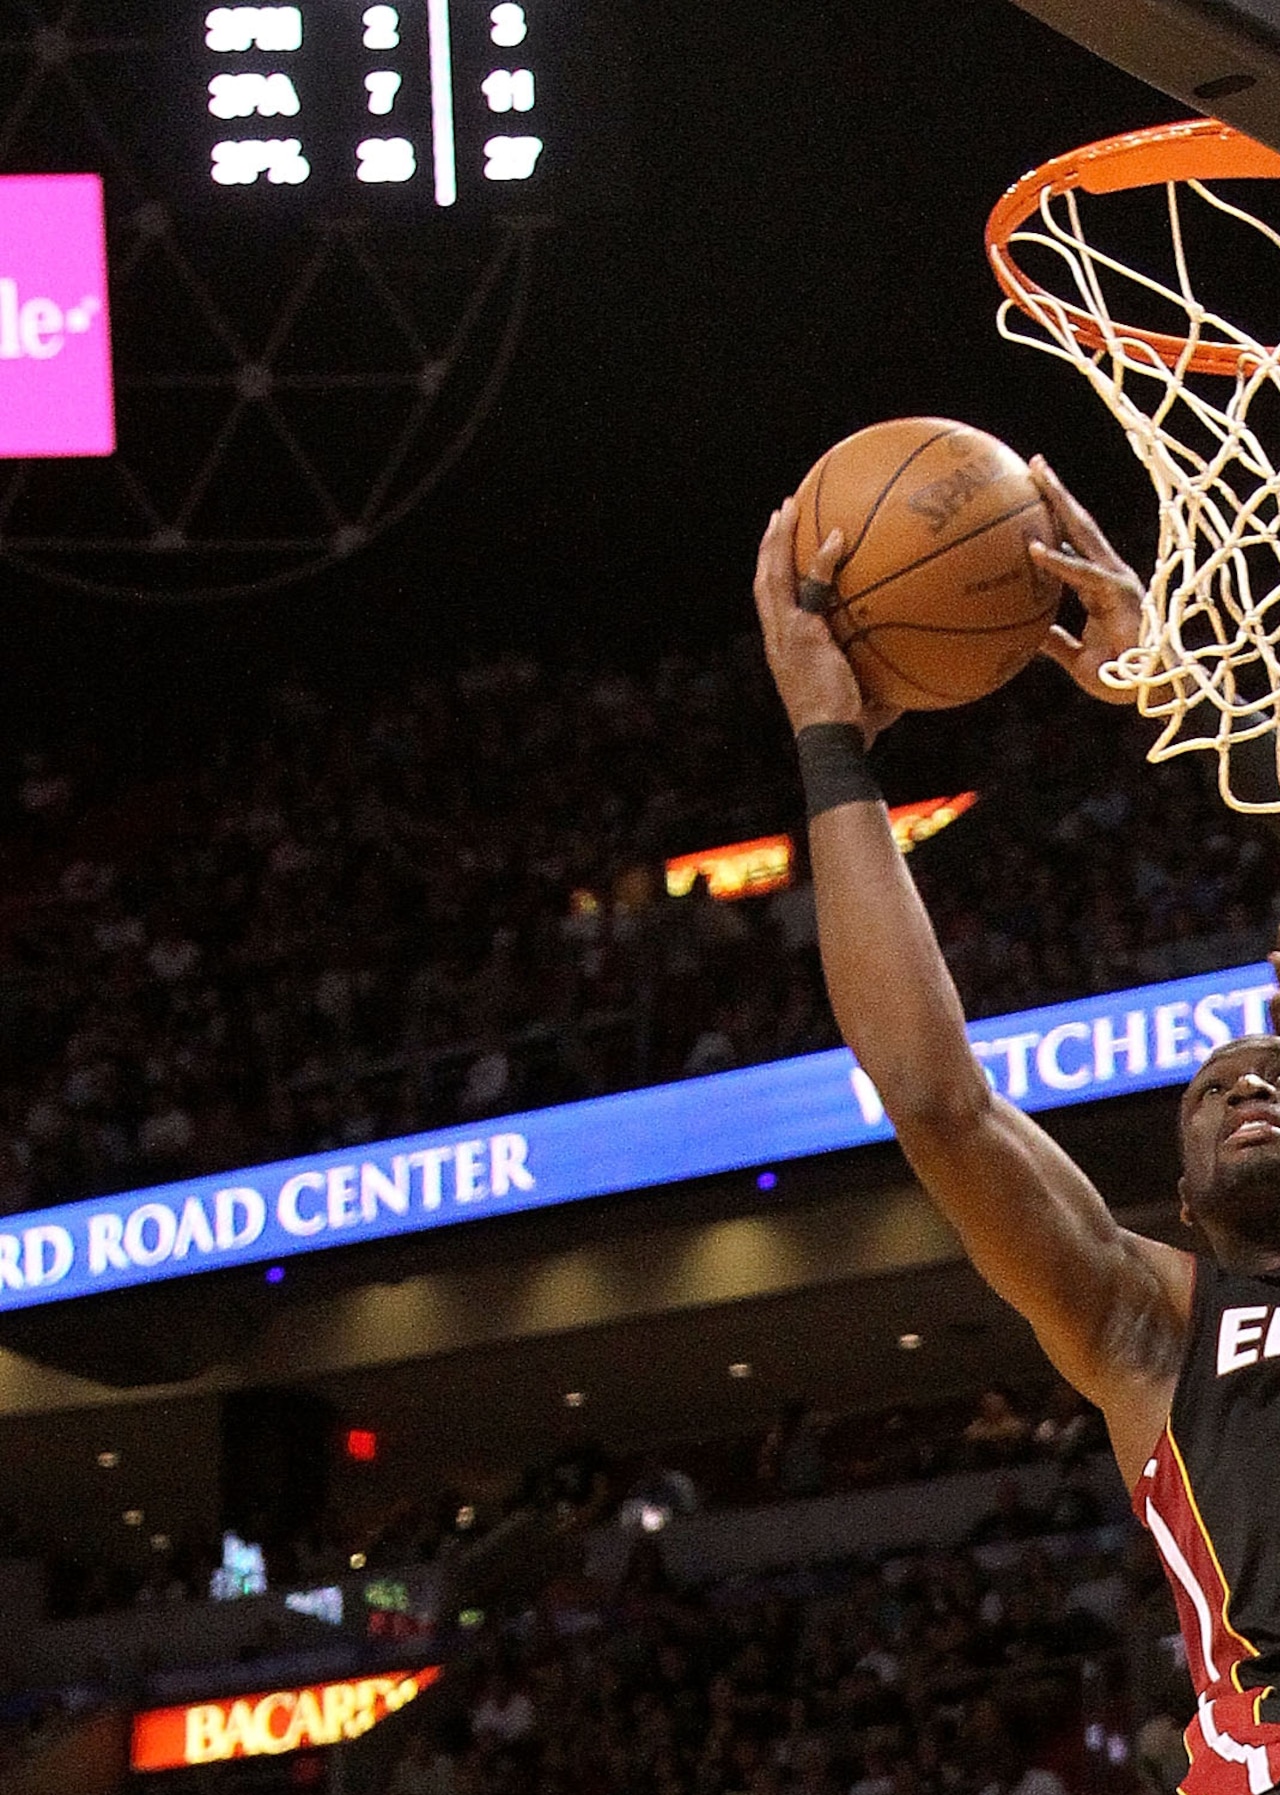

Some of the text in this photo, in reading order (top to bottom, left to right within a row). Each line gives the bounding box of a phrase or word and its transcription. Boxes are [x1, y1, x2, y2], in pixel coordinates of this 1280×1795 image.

[365, 70, 402, 115] 7
[88, 1188, 266, 1276] ROAD
[278, 1132, 534, 1237] CENTER
